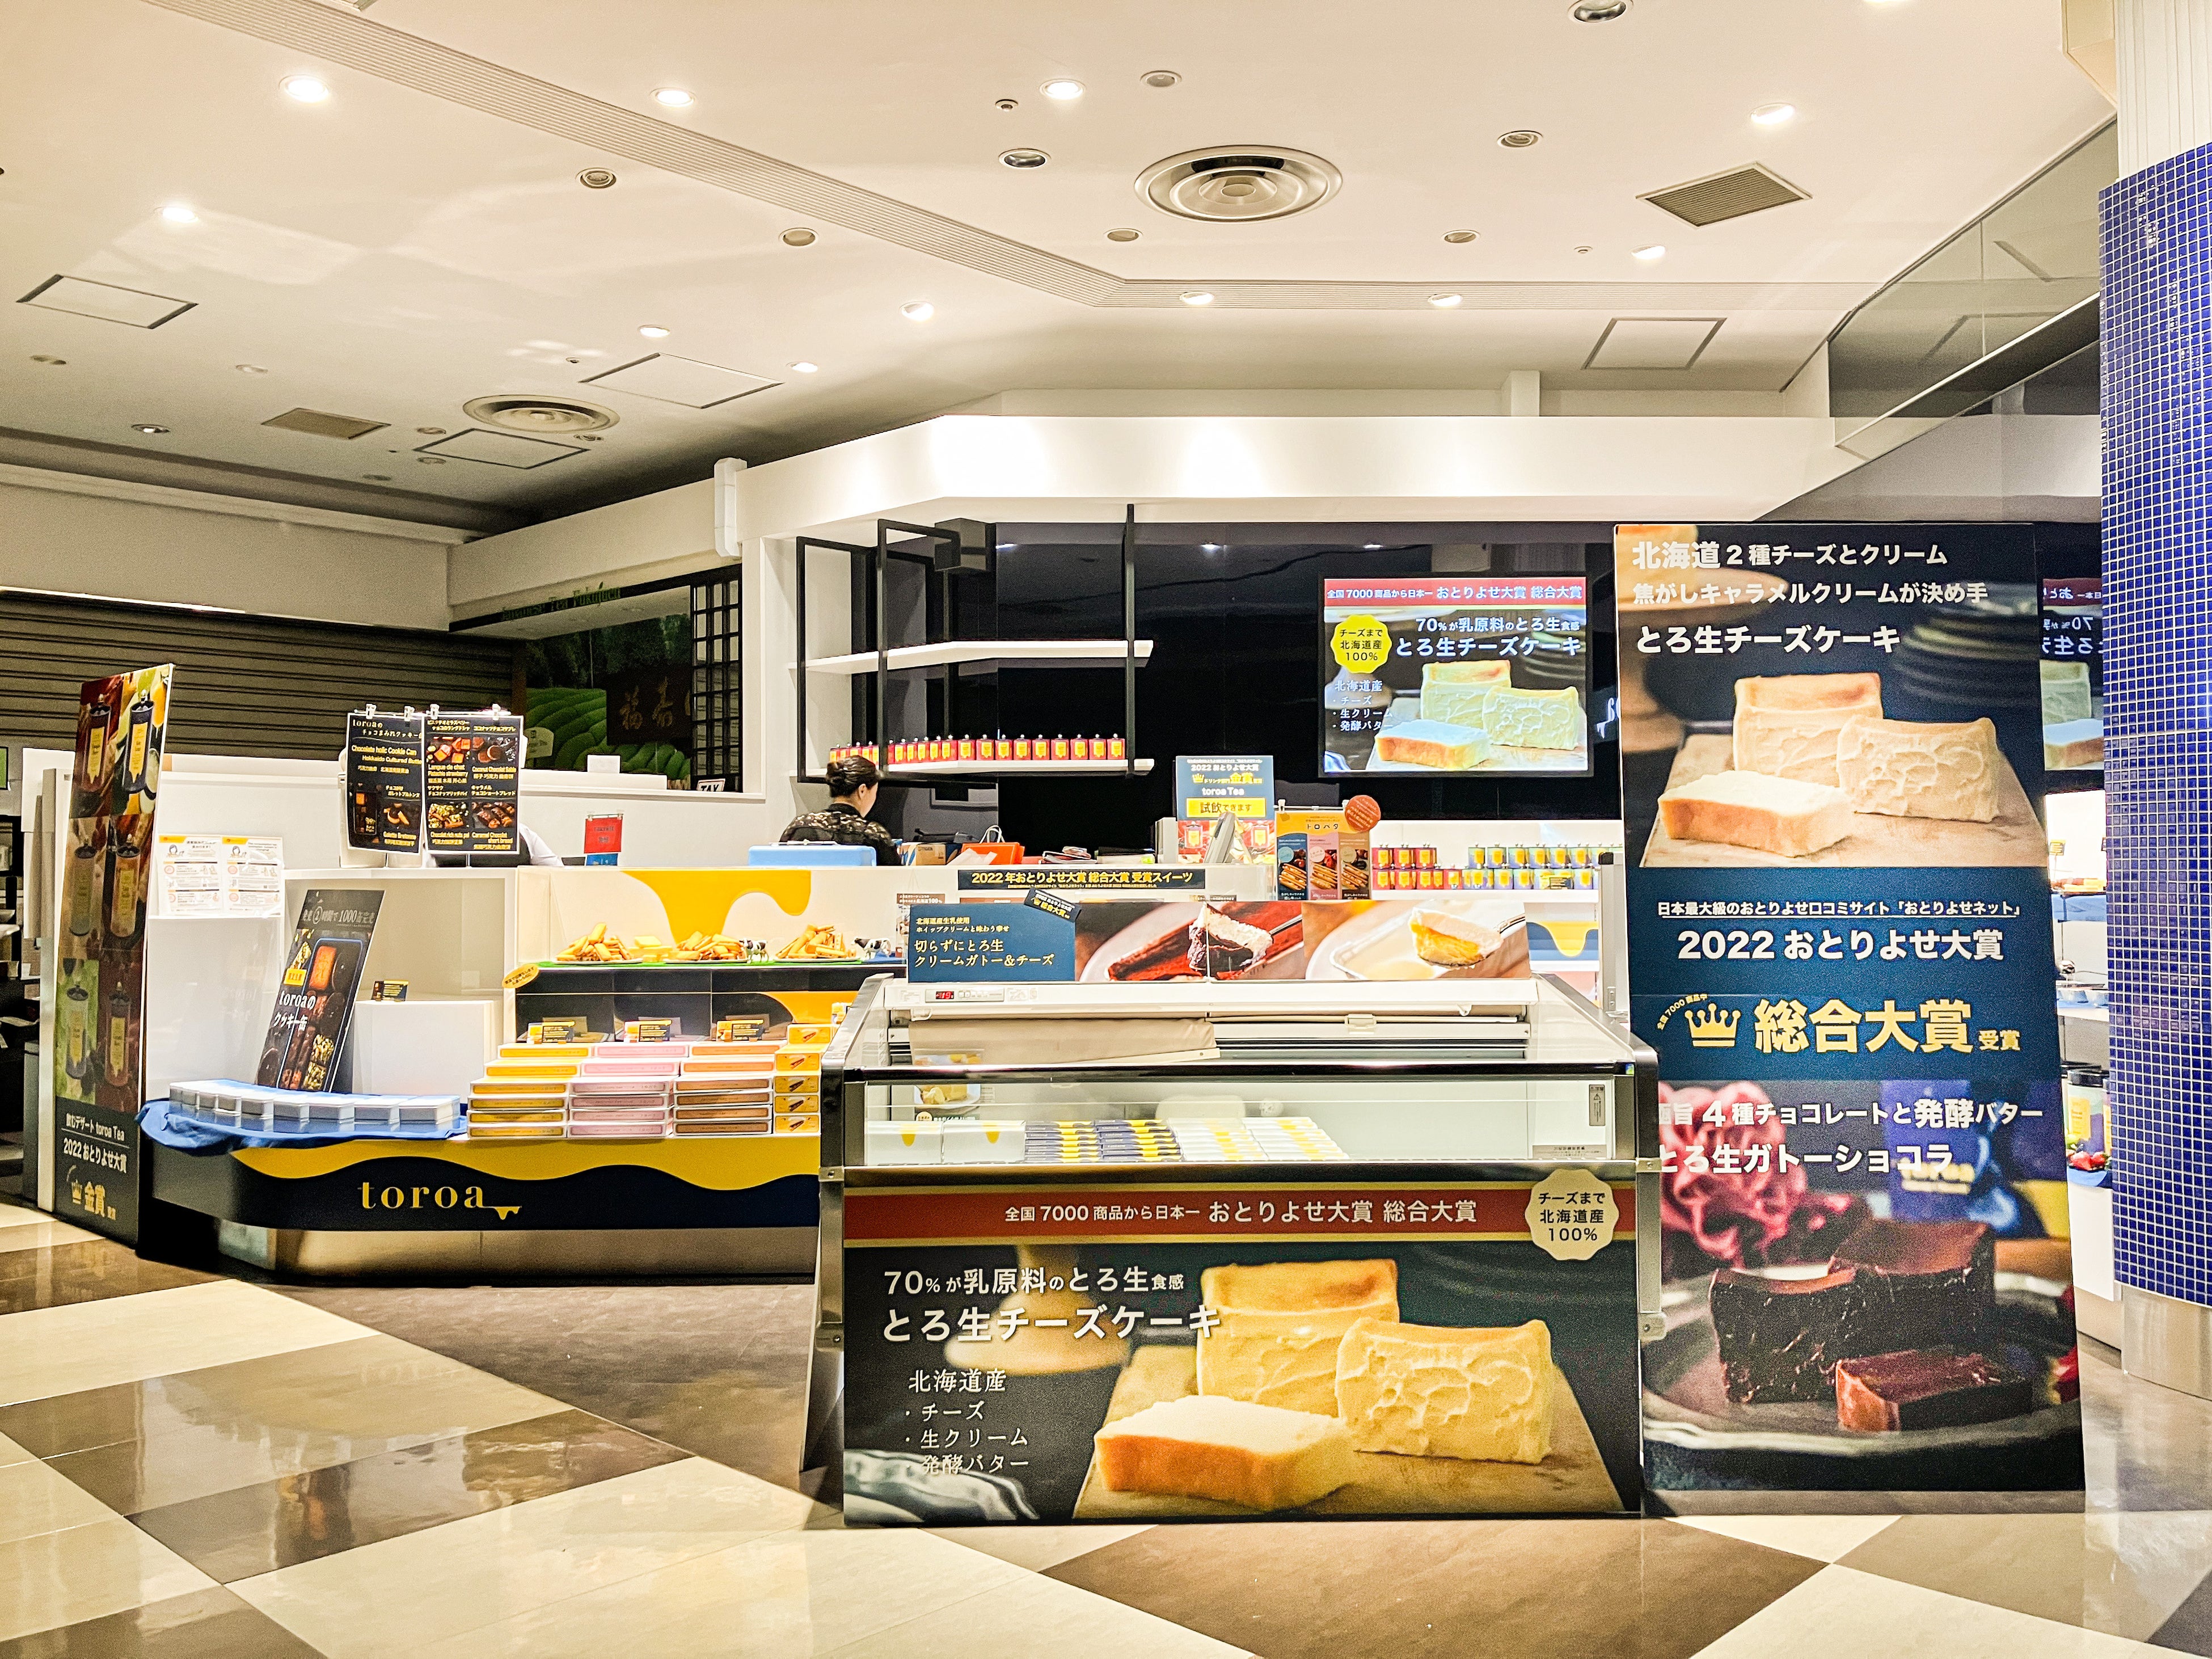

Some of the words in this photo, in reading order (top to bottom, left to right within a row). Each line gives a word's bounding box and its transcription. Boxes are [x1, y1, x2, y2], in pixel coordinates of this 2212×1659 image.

[1632, 541, 1720, 570] 北海道
[1727, 544, 1743, 565] 2
[1749, 543, 1948, 567] 種チーズとクリーム
[1346, 589, 1373, 598] 7000
[1633, 581, 1989, 605] 焦がしキャラメルクリームが決め手
[1340, 628, 1383, 638] チーズまで
[1636, 625, 1900, 655] とろ生チーズケーキ
[1340, 639, 1383, 651] 北海道産
[1396, 638, 1581, 657] とろ生チーズケーキ
[1345, 652, 1378, 661] 100%
[1335, 680, 1383, 693] 北海道産
[1202, 787, 1226, 796] toroa
[1227, 787, 1244, 796] Tea
[1200, 802, 1252, 813] 試飲できます
[972, 873, 1003, 884] 2022
[914, 939, 1004, 953] 切らずにとろ生
[1678, 931, 1775, 960] 2022
[1784, 930, 2004, 961] おとりよせ大賞
[914, 953, 1056, 968] クリームガトー&チーズ
[278, 989, 316, 1010] toroaの
[1754, 999, 1973, 1054] 総合大賞
[1978, 1031, 2021, 1052] 受賞
[1702, 1100, 1726, 1128] 4
[1732, 1099, 2043, 1130] 種チョコレートと発酵バター
[95, 1121, 112, 1138] toroa
[113, 1125, 125, 1142] Tea
[64, 1137, 82, 1159] 2022
[1659, 1145, 1953, 1175] とろ生ガトーショコラ
[357, 1182, 513, 1214] toroa
[1538, 1192, 1606, 1205] チーズまで
[1005, 1207, 1036, 1222] 全国
[1040, 1205, 1089, 1221] 7000
[1093, 1206, 1200, 1221] 商品から日本一
[1208, 1200, 1374, 1224] おとりよせ大賞
[1383, 1200, 1477, 1223] 総合大賞
[1539, 1209, 1605, 1224] 北海道産
[1547, 1227, 1598, 1242] 100%
[883, 1305, 1221, 1342] とろ生チーズケーキ
[909, 1369, 1007, 1394] 北海道産
